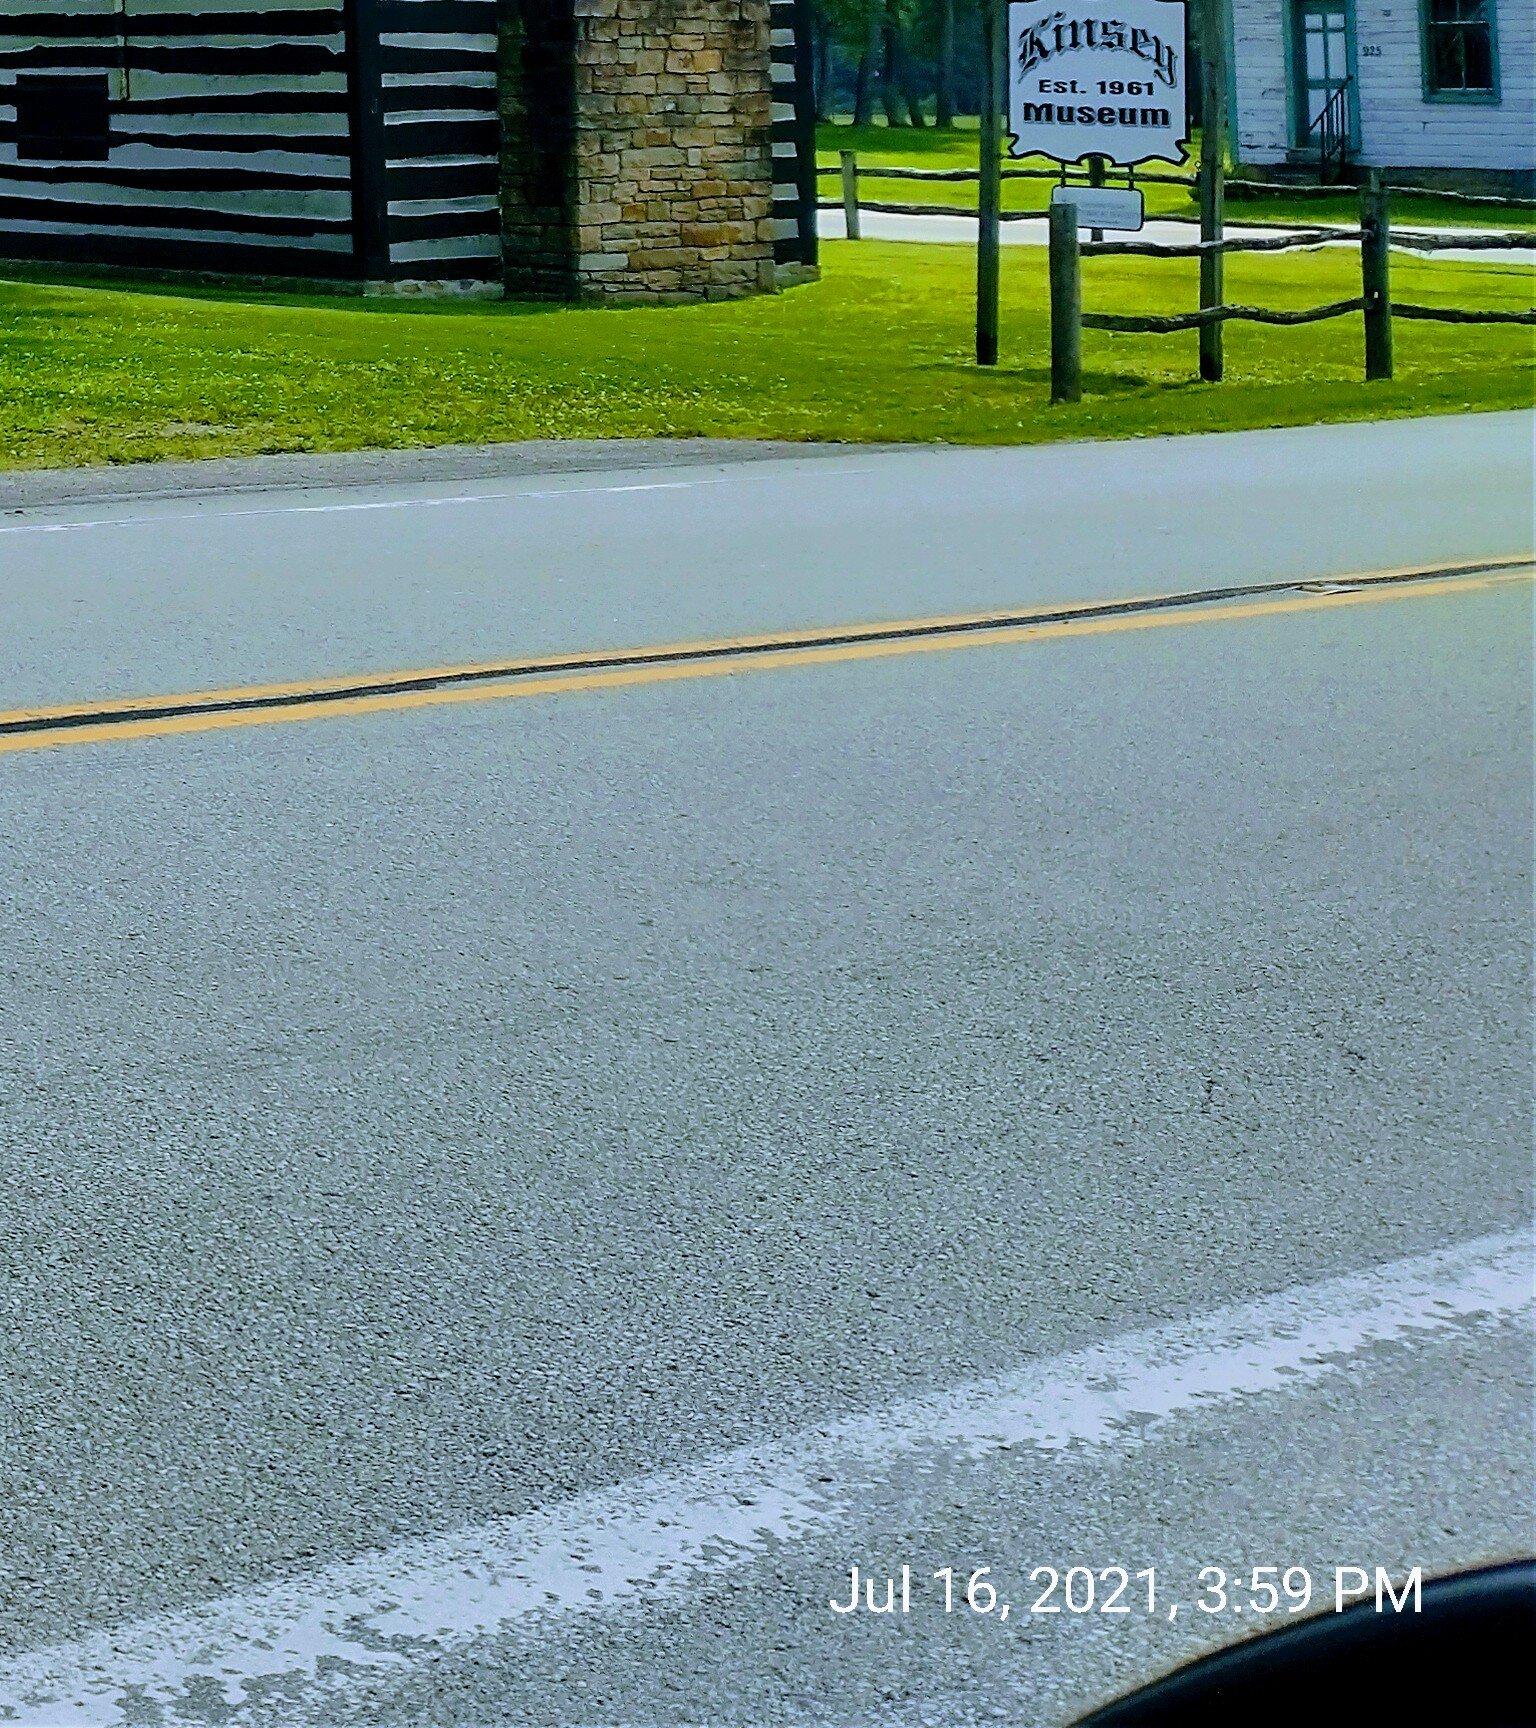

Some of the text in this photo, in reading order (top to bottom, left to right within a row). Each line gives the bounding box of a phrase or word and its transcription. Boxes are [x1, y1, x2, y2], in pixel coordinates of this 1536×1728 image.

[1018, 11, 1177, 86] Kinsey
[1038, 79, 1155, 96] Est. 1961
[1022, 102, 1171, 126] Museum
